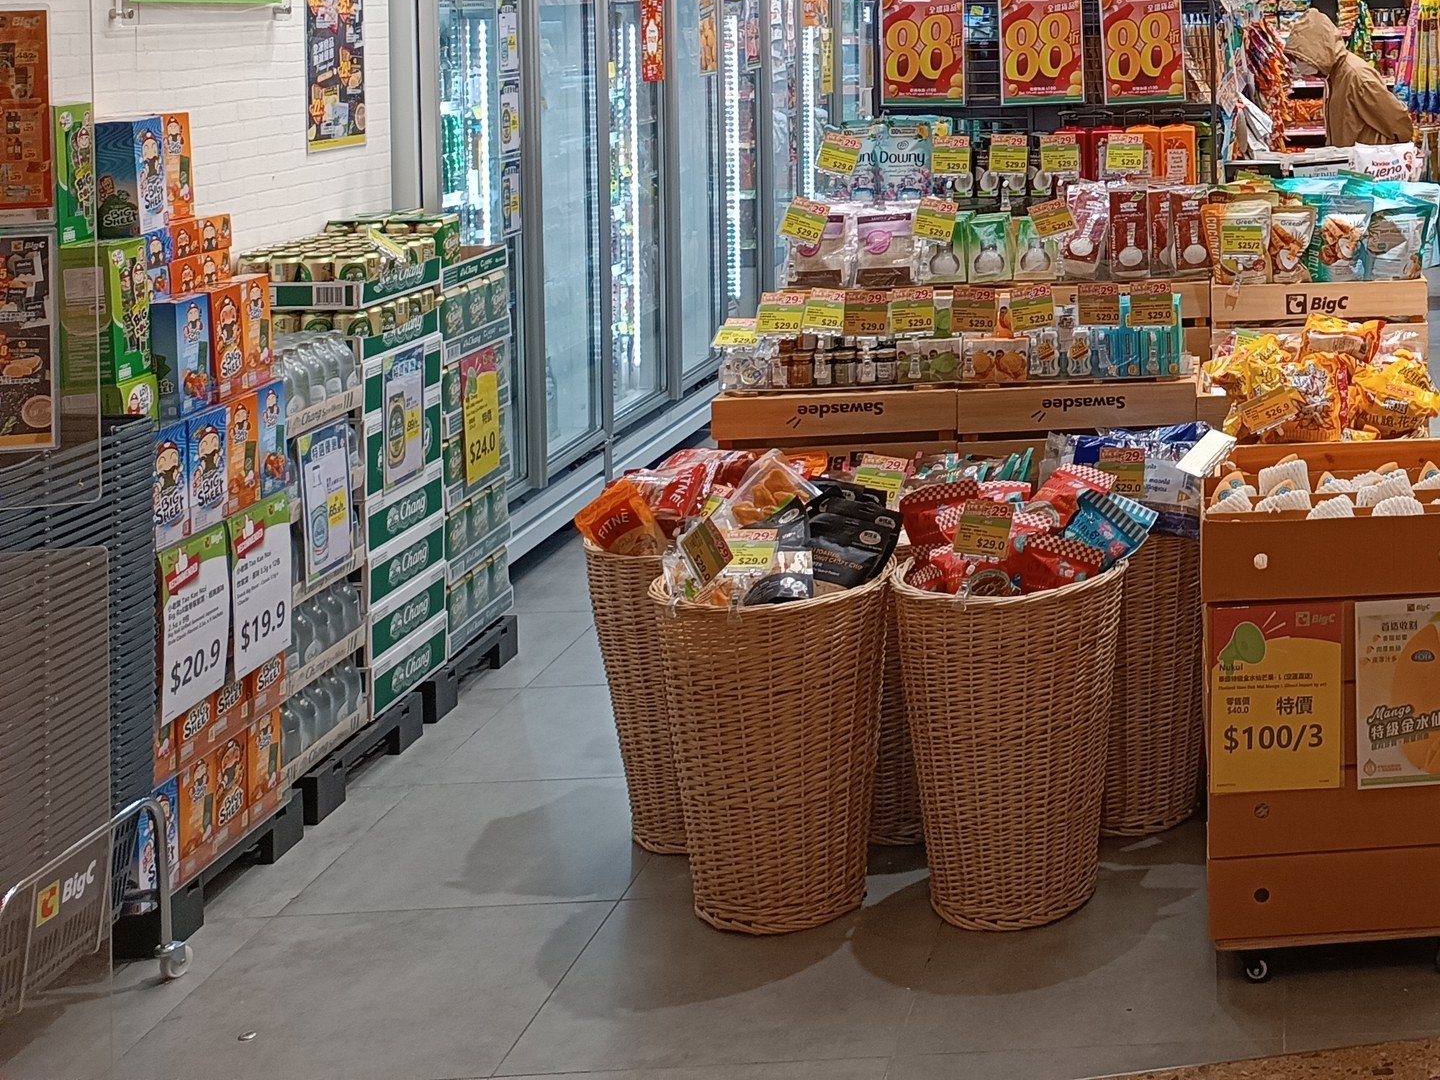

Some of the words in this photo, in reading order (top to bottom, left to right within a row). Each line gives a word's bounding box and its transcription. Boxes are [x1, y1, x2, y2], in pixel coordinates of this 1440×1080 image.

[886, 14, 953, 82] 88
[1005, 12, 1073, 83] 88
[1107, 12, 1174, 82] 88
[832, 160, 853, 171] $29.0
[880, 151, 925, 167] Downy
[1005, 161, 1026, 169] $29.0
[1364, 165, 1402, 177] bueno
[796, 226, 819, 239] $29.0
[1238, 241, 1260, 249] $25/2
[1310, 296, 1349, 313] BigC
[908, 319, 932, 327] $29.0
[1030, 313, 1053, 323] $29.0
[1148, 311, 1171, 319] $29.0
[798, 402, 884, 418] Sawasdee
[1042, 396, 1125, 411] Sawasdee
[1265, 403, 1290, 419] $26.9
[469, 432, 496, 466] $24.0
[1115, 483, 1141, 493] $29.0
[400, 493, 426, 519] Chang
[402, 544, 428, 569] Chang
[404, 595, 430, 621] Chang
[241, 601, 286, 651] $19.9
[1312, 613, 1335, 625] BigC
[170, 639, 221, 695] $20.9
[405, 649, 430, 674] Chang
[1227, 706, 1249, 714] $40.0
[1276, 696, 1313, 715] 特價
[1368, 705, 1411, 723] Mango
[1223, 723, 1323, 753] $100/3
[62, 860, 97, 904] BigC
